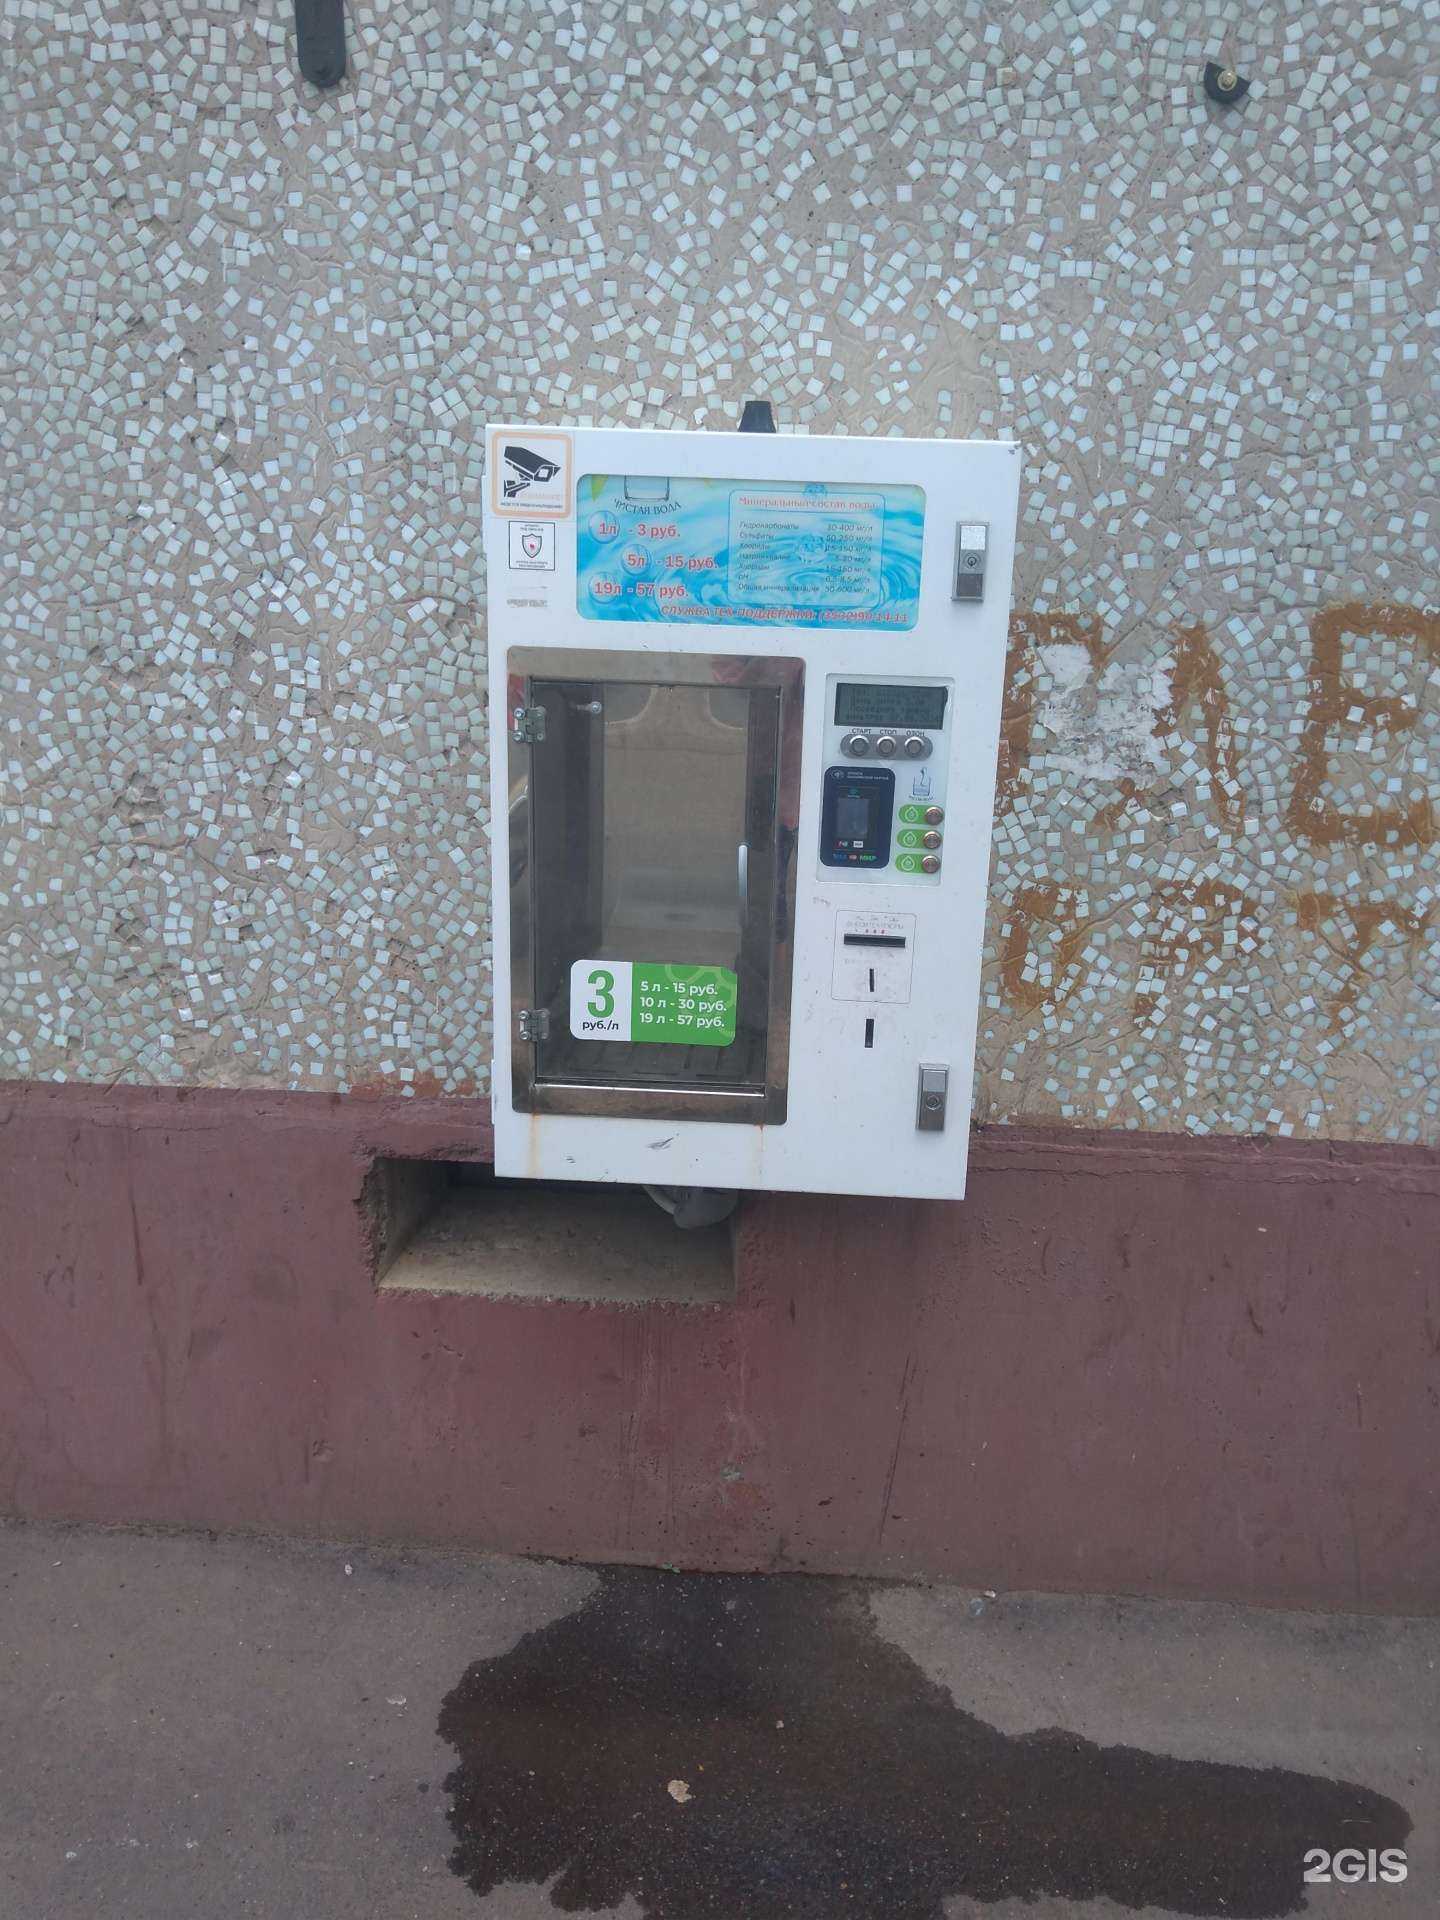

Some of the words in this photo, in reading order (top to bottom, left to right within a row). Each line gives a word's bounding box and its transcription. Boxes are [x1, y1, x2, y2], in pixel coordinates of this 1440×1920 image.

[614, 498, 651, 515] ЧИСТАЯ
[653, 501, 682, 515] ВОДА
[599, 522, 617, 535] 1л
[637, 523, 647, 537] 3
[650, 524, 681, 540] руб.
[627, 553, 645, 567] 5л
[665, 555, 684, 568] 15
[687, 555, 718, 571] руб.
[594, 581, 621, 595] 19л
[636, 583, 655, 596] 57
[659, 586, 689, 599] руб.
[661, 606, 711, 616] СЛУЖБА
[587, 969, 615, 1018] 3
[639, 980, 649, 991] 5
[652, 983, 661, 992] л
[672, 982, 686, 993] 15
[689, 984, 718, 996] руб.
[639, 997, 655, 1008] 10
[657, 999, 667, 1008] л
[678, 998, 695, 1009] 30
[698, 1000, 727, 1012] руб.
[582, 1019, 619, 1031] руб./л
[639, 1012, 654, 1024] 19
[655, 1015, 665, 1024] л
[677, 1014, 693, 1025] 57
[696, 1016, 725, 1028] руб.
